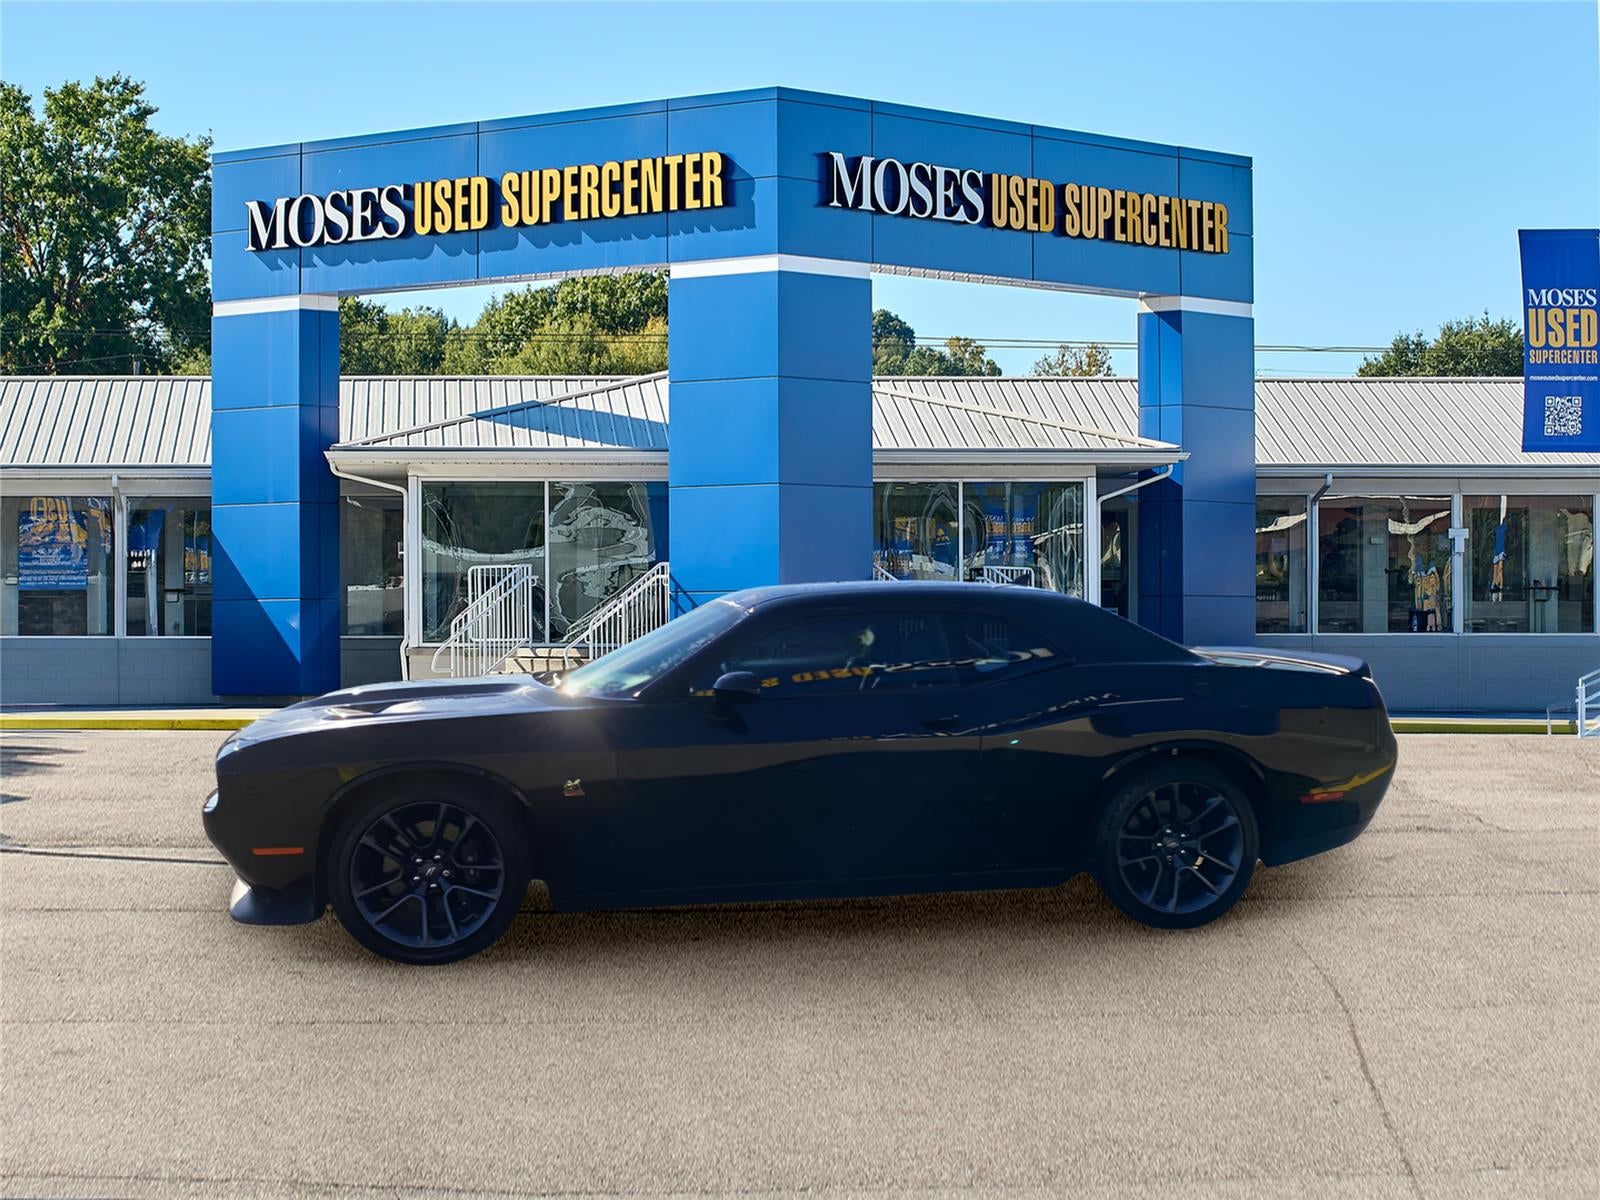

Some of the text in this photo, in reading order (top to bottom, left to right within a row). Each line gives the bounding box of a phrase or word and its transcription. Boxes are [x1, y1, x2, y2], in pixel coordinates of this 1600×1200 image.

[245, 151, 724, 251] MOSES USED SUPERCENTER
[829, 152, 1230, 254] MOSES USED SUPERCENTER
[1528, 288, 1597, 307] MOSES
[1528, 308, 1598, 348] USED
[1529, 350, 1598, 364] SUPERCENTER
